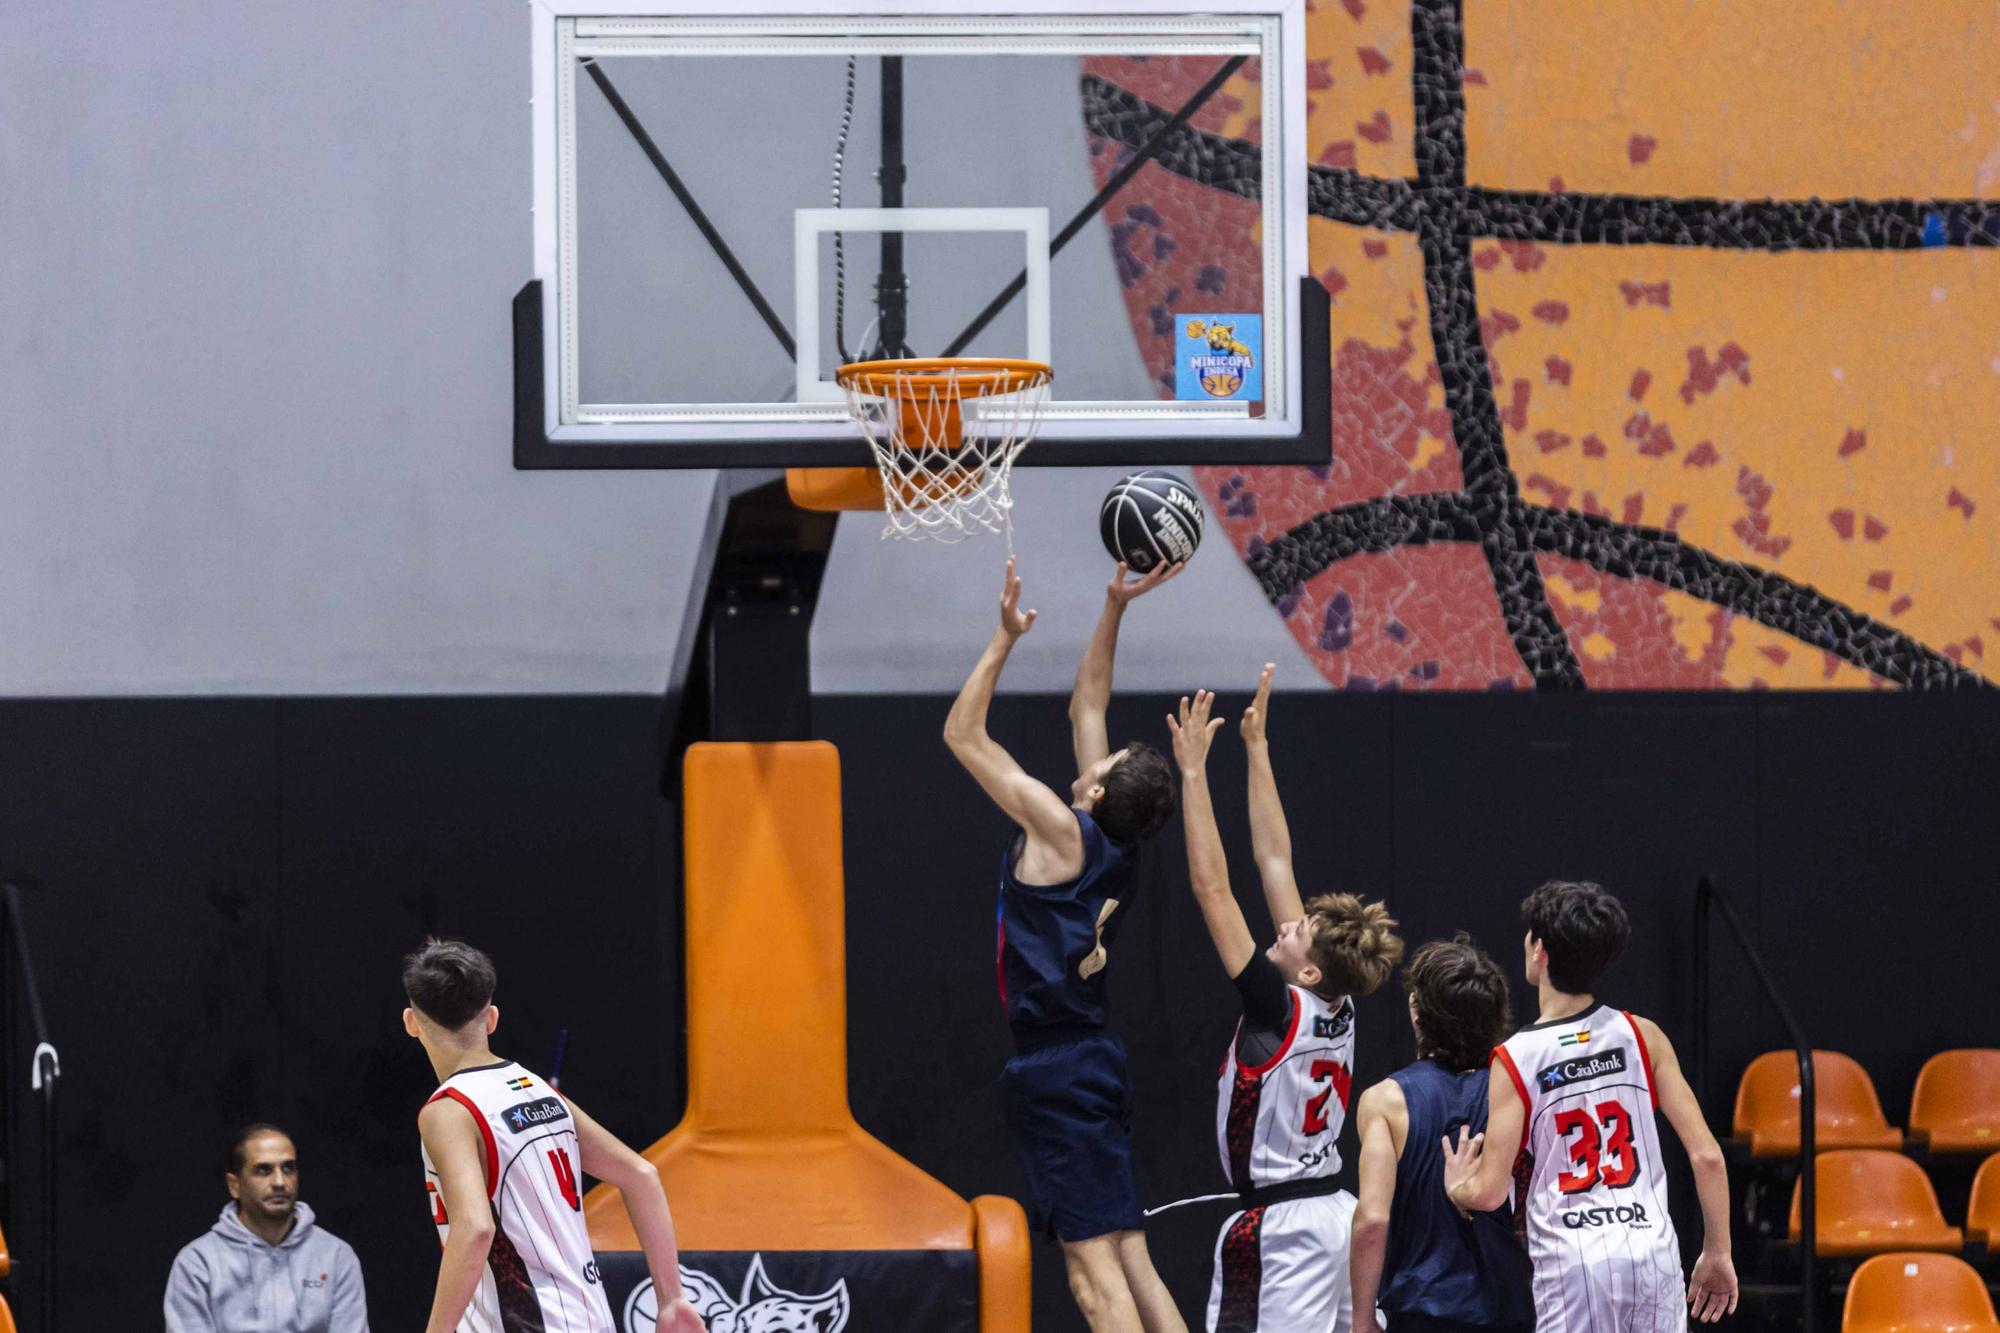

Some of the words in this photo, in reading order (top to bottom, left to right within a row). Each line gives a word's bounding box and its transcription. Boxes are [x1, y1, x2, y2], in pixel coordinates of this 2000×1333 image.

[1191, 356, 1252, 368] MINICOPA
[1564, 1054, 1622, 1079] CaixaBank
[1555, 1100, 1641, 1195] 33
[1562, 1202, 1648, 1229] CASTOR
